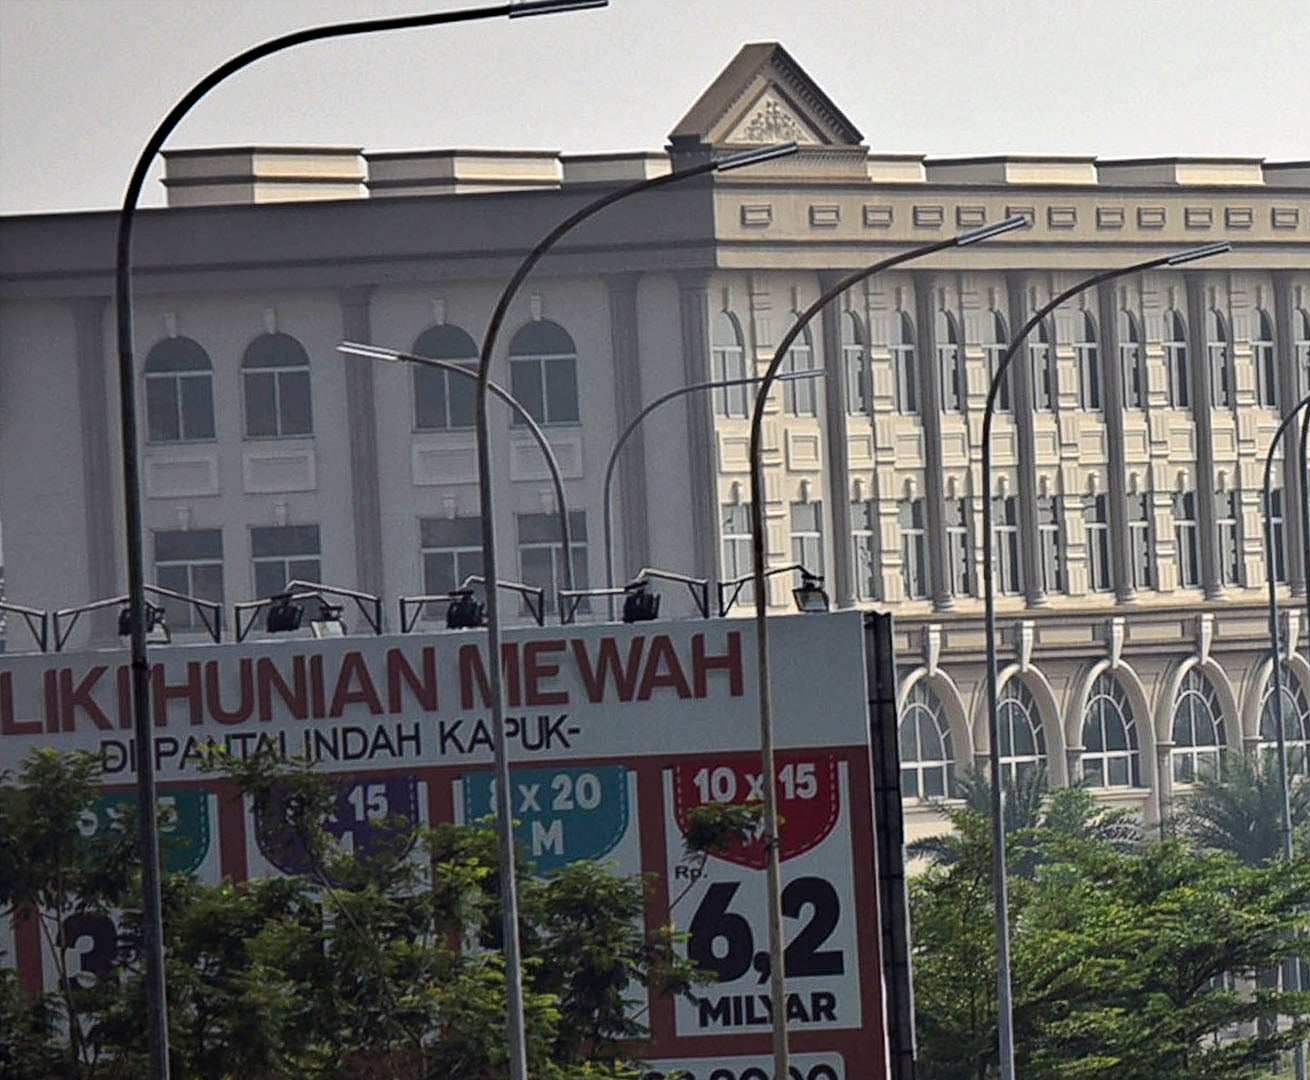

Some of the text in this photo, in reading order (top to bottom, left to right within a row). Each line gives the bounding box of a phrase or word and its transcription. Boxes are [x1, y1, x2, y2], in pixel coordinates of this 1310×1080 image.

[151, 646, 440, 728] HUNIAN
[458, 631, 744, 711] MEWAH
[100, 738, 137, 774] DI
[304, 722, 422, 765] INDAH
[347, 784, 389, 821] 15
[517, 783, 542, 813] x
[550, 773, 602, 811] 20
[693, 766, 737, 803] 10
[778, 763, 818, 799] 15
[531, 819, 565, 856] M
[674, 865, 708, 881] Rp.
[686, 876, 845, 985] 6,2
[699, 991, 838, 1028] MILYAR
